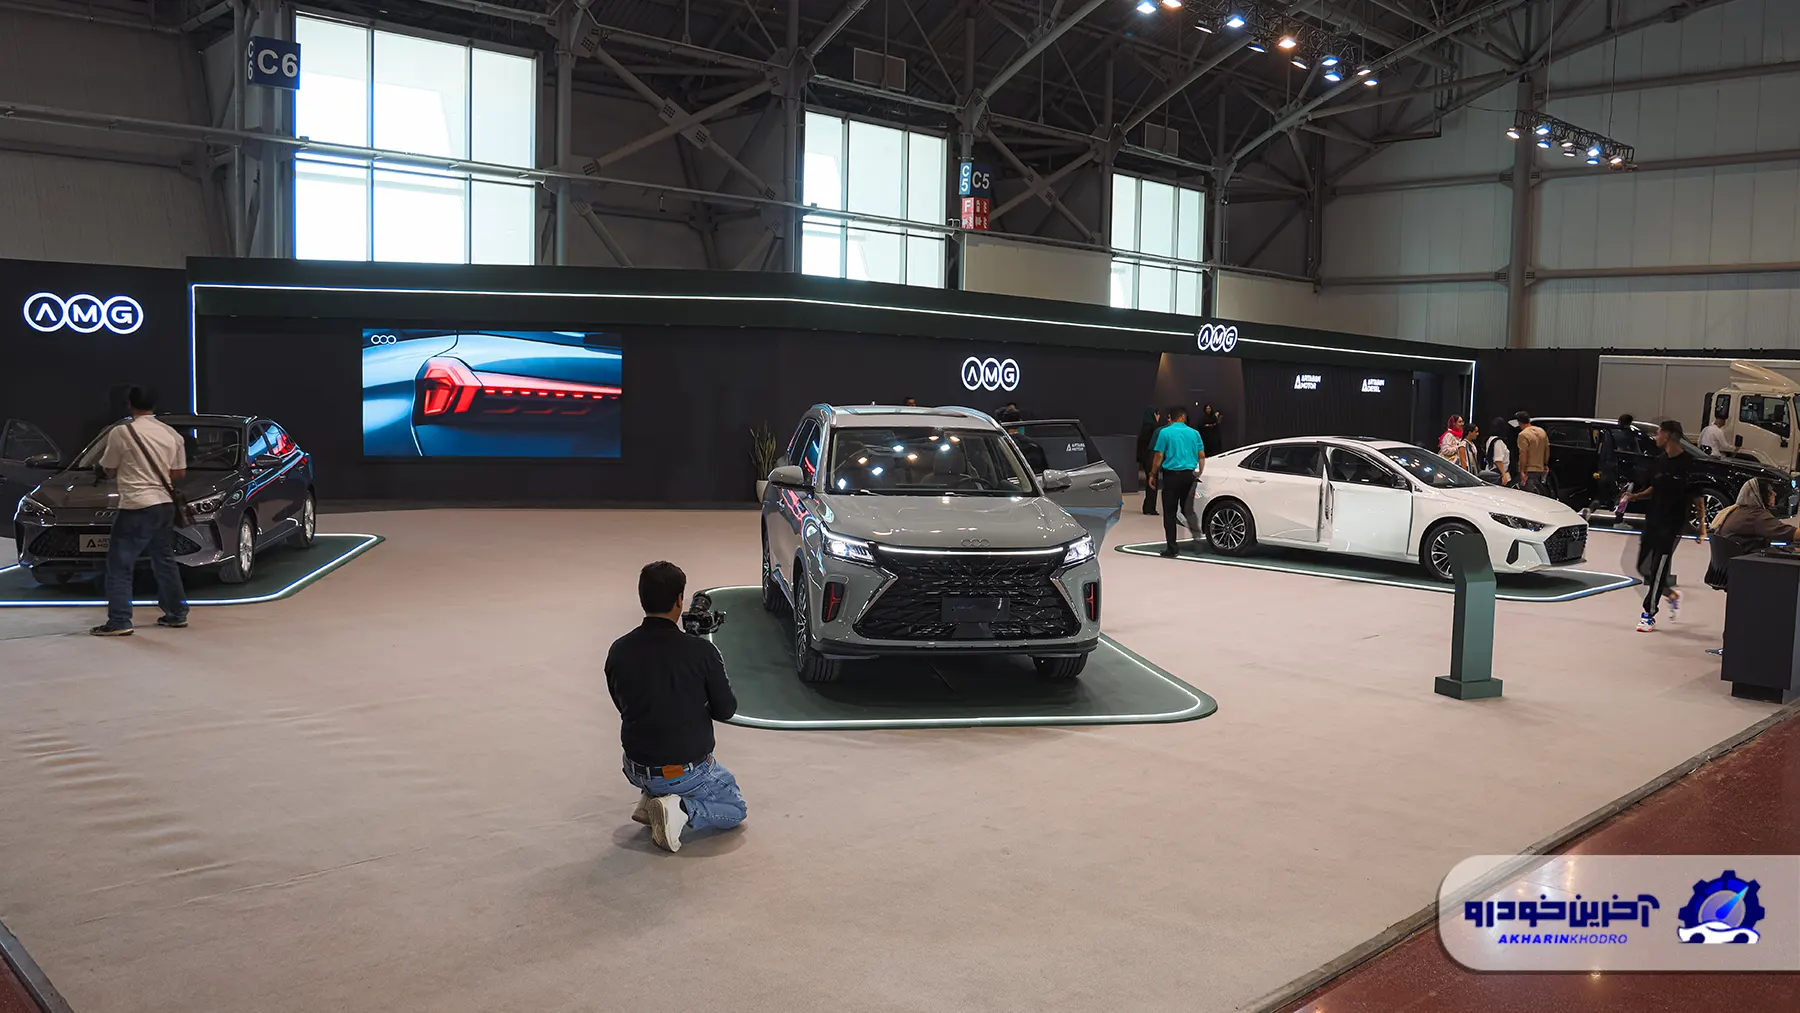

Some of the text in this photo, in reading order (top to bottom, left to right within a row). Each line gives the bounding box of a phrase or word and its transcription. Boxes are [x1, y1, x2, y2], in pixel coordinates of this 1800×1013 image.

[248, 40, 254, 80] C6
[257, 49, 298, 78] C6
[961, 165, 970, 192] C5
[972, 171, 990, 189] C5
